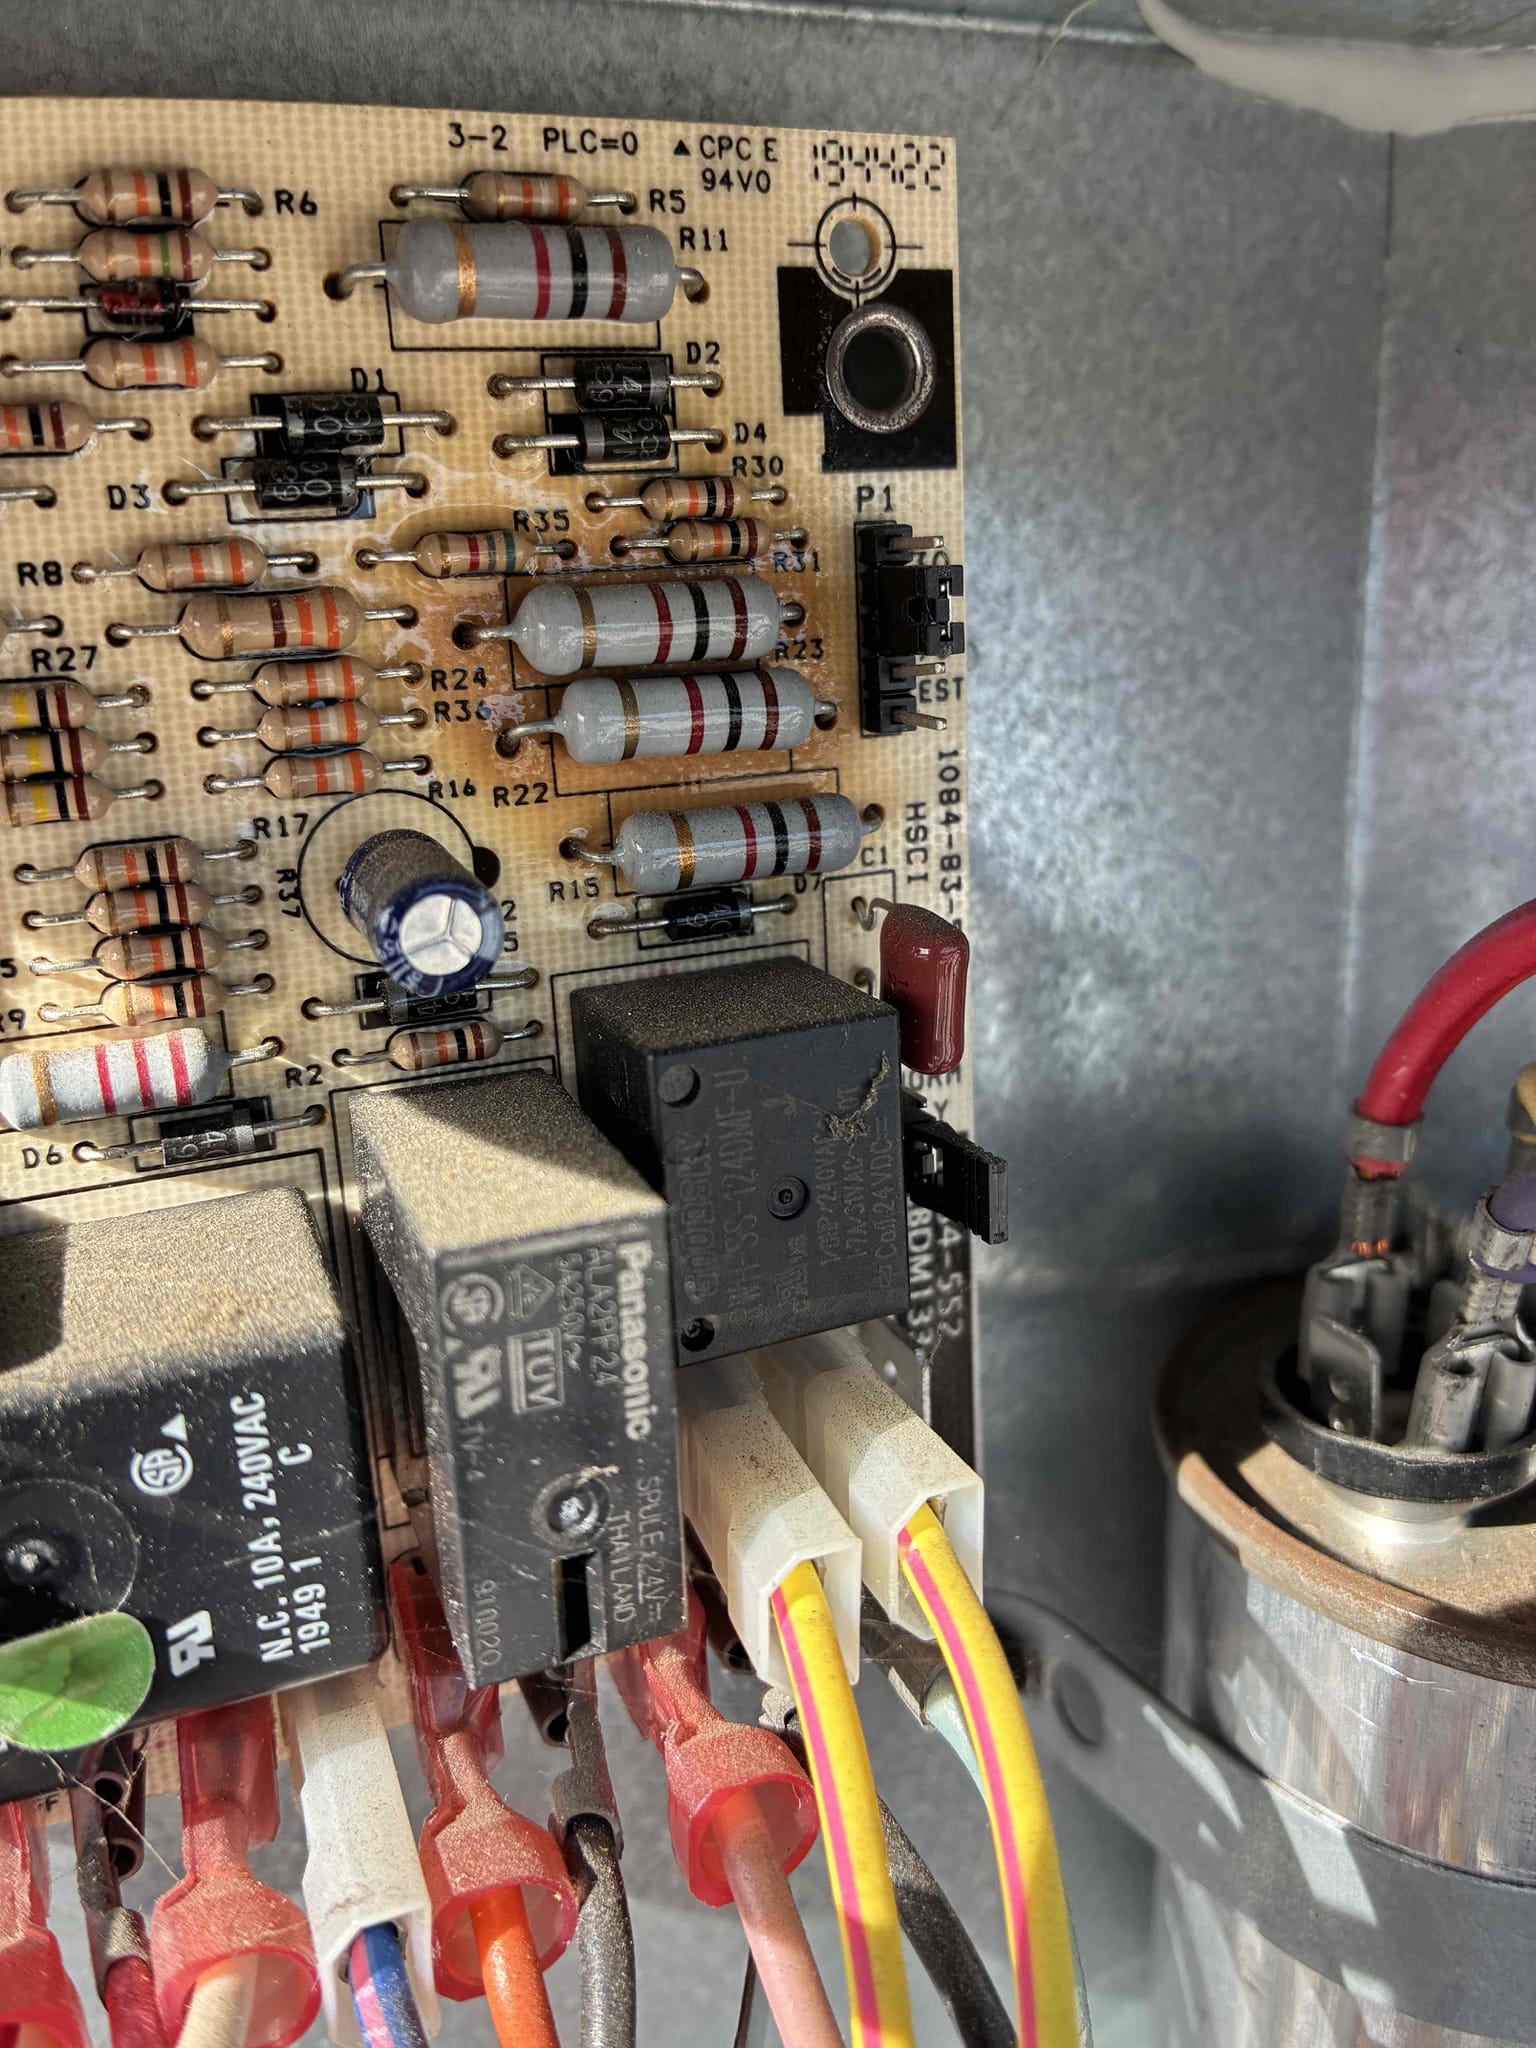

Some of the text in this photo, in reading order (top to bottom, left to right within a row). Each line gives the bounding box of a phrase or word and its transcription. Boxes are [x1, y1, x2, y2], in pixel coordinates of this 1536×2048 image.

[448, 122, 638, 155] 3-2 PLC=0
[700, 135, 757, 162] CPC
[275, 189, 319, 216] R6
[650, 188, 686, 214] R5
[679, 226, 728, 252] R11
[686, 342, 720, 366] D2
[351, 367, 388, 393] D1
[734, 422, 766, 445] D4
[732, 455, 784, 477] R30
[107, 484, 151, 510] D3
[856, 485, 893, 513] P1
[513, 509, 570, 533] R35
[17, 561, 64, 587] R8
[773, 551, 820, 574] R31
[31, 645, 98, 673] R27
[775, 637, 825, 662] R23
[431, 667, 488, 692] R24
[918, 677, 964, 703] EST
[428, 779, 477, 801] R16
[493, 781, 550, 808] R22
[252, 812, 309, 840] R17
[937, 749, 963, 930] 1084-83-
[860, 846, 888, 868] C1
[549, 877, 600, 902] R15
[285, 1063, 324, 1089] R2
[22, 1144, 64, 1170] D6
[616, 1239, 658, 1442] Panasonic
[230, 1391, 278, 1511] 240VAC
[277, 1442, 314, 1467] C
[293, 1582, 332, 1656] 1949
